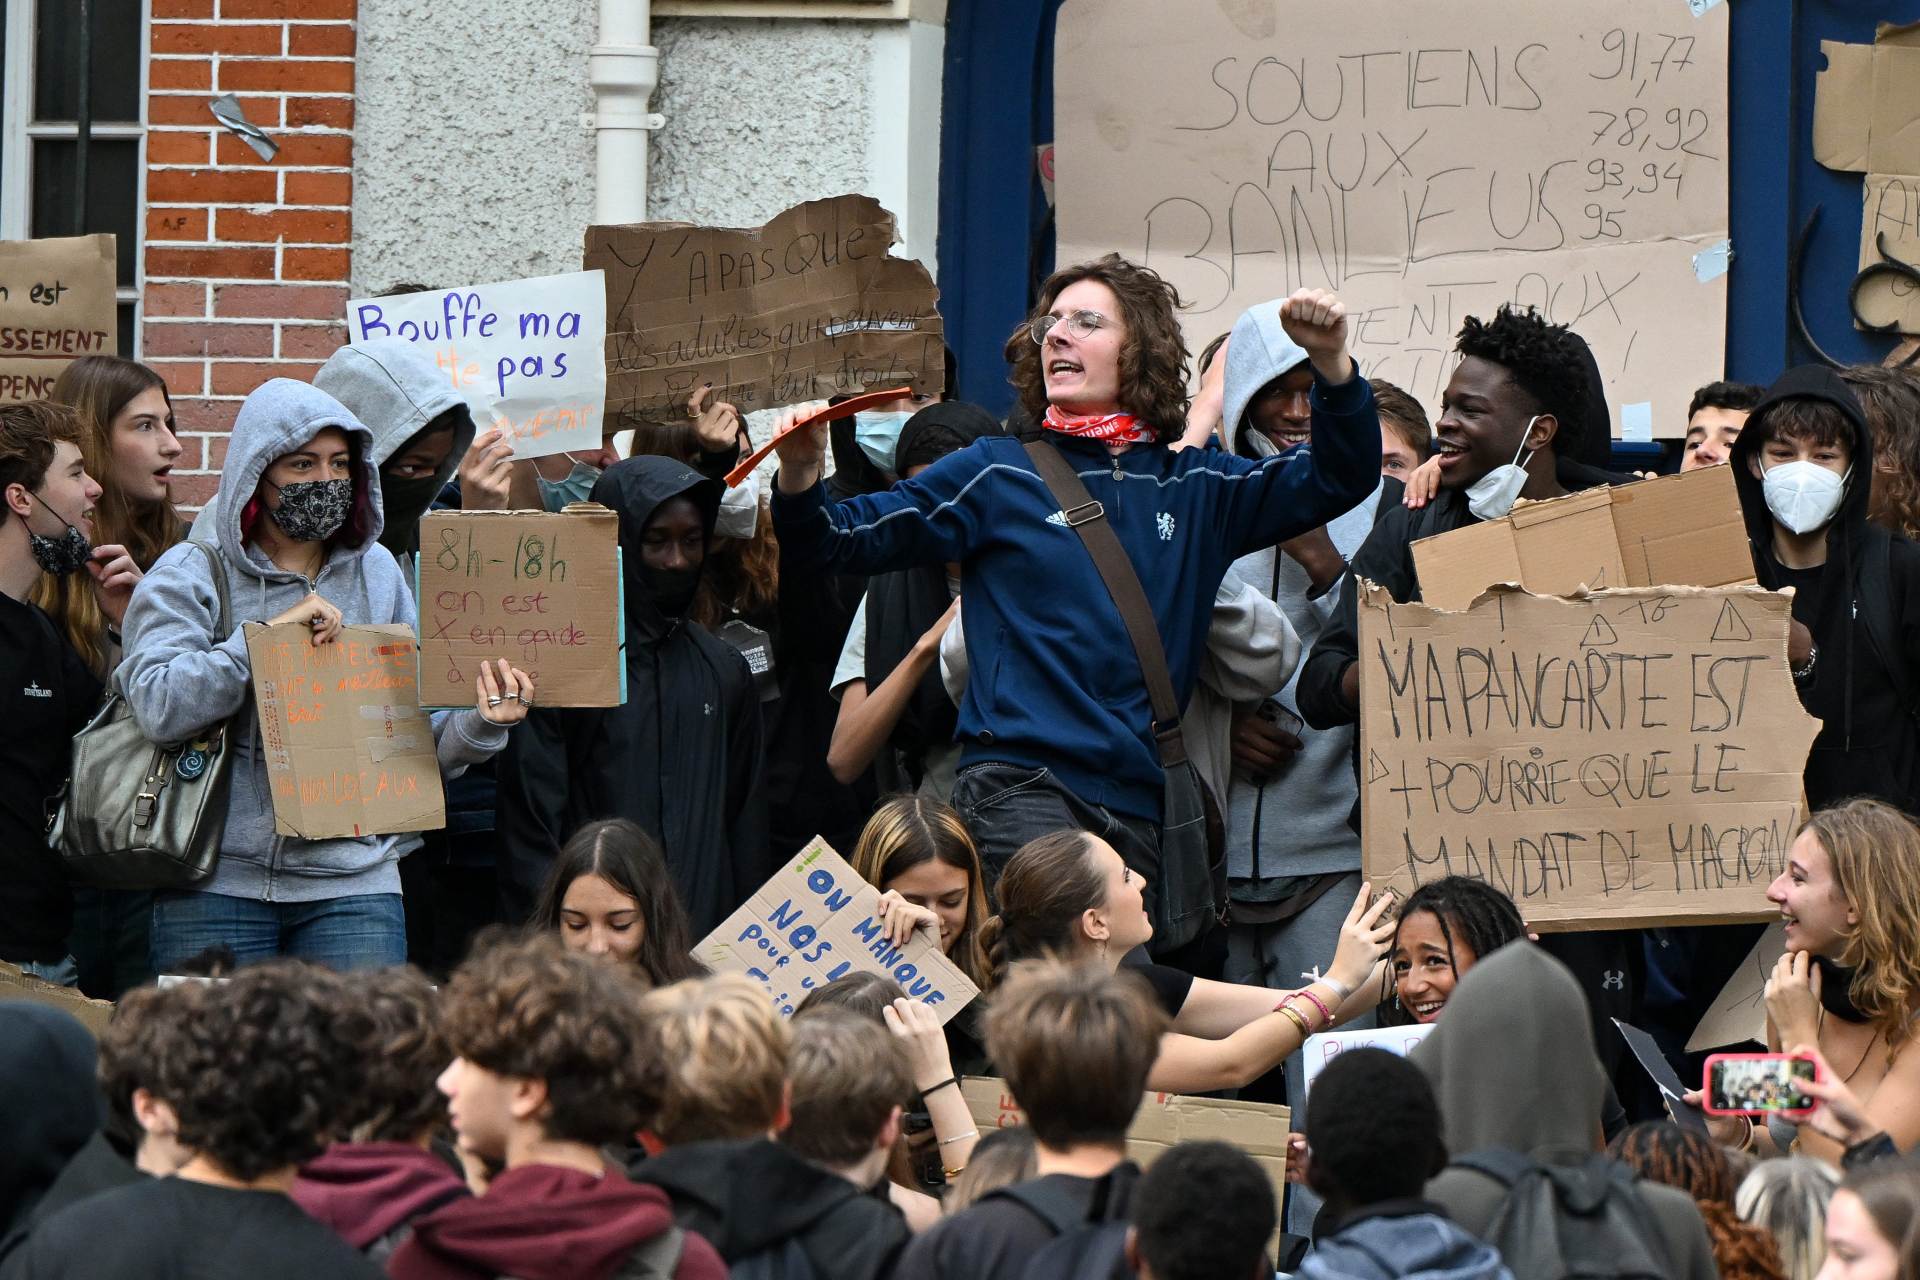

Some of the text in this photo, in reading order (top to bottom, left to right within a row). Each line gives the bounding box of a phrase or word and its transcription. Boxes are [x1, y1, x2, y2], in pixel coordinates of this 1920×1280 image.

[1175, 44, 1548, 131] SOUTIENS
[1588, 107, 1719, 160] 78,92
[1267, 128, 1428, 193] AUX
[1584, 158, 1685, 200] 93,94
[1580, 203, 1626, 241] 95
[719, 248, 776, 292] PAS
[30, 280, 69, 306] est
[1, 327, 109, 353] SSEMENT
[519, 312, 582, 340] ma
[497, 352, 568, 397] pas
[436, 590, 551, 616] on est
[470, 623, 506, 646] en
[516, 620, 589, 664] garde
[1378, 636, 1771, 742] MA PANCARTE EST
[1579, 750, 1672, 808] QUE
[1690, 743, 1746, 794] LE
[1403, 826, 1588, 899] MANDAT
[1599, 829, 1655, 898] DE
[767, 898, 833, 963] NOS
[807, 869, 946, 1006] ON MANQUE
